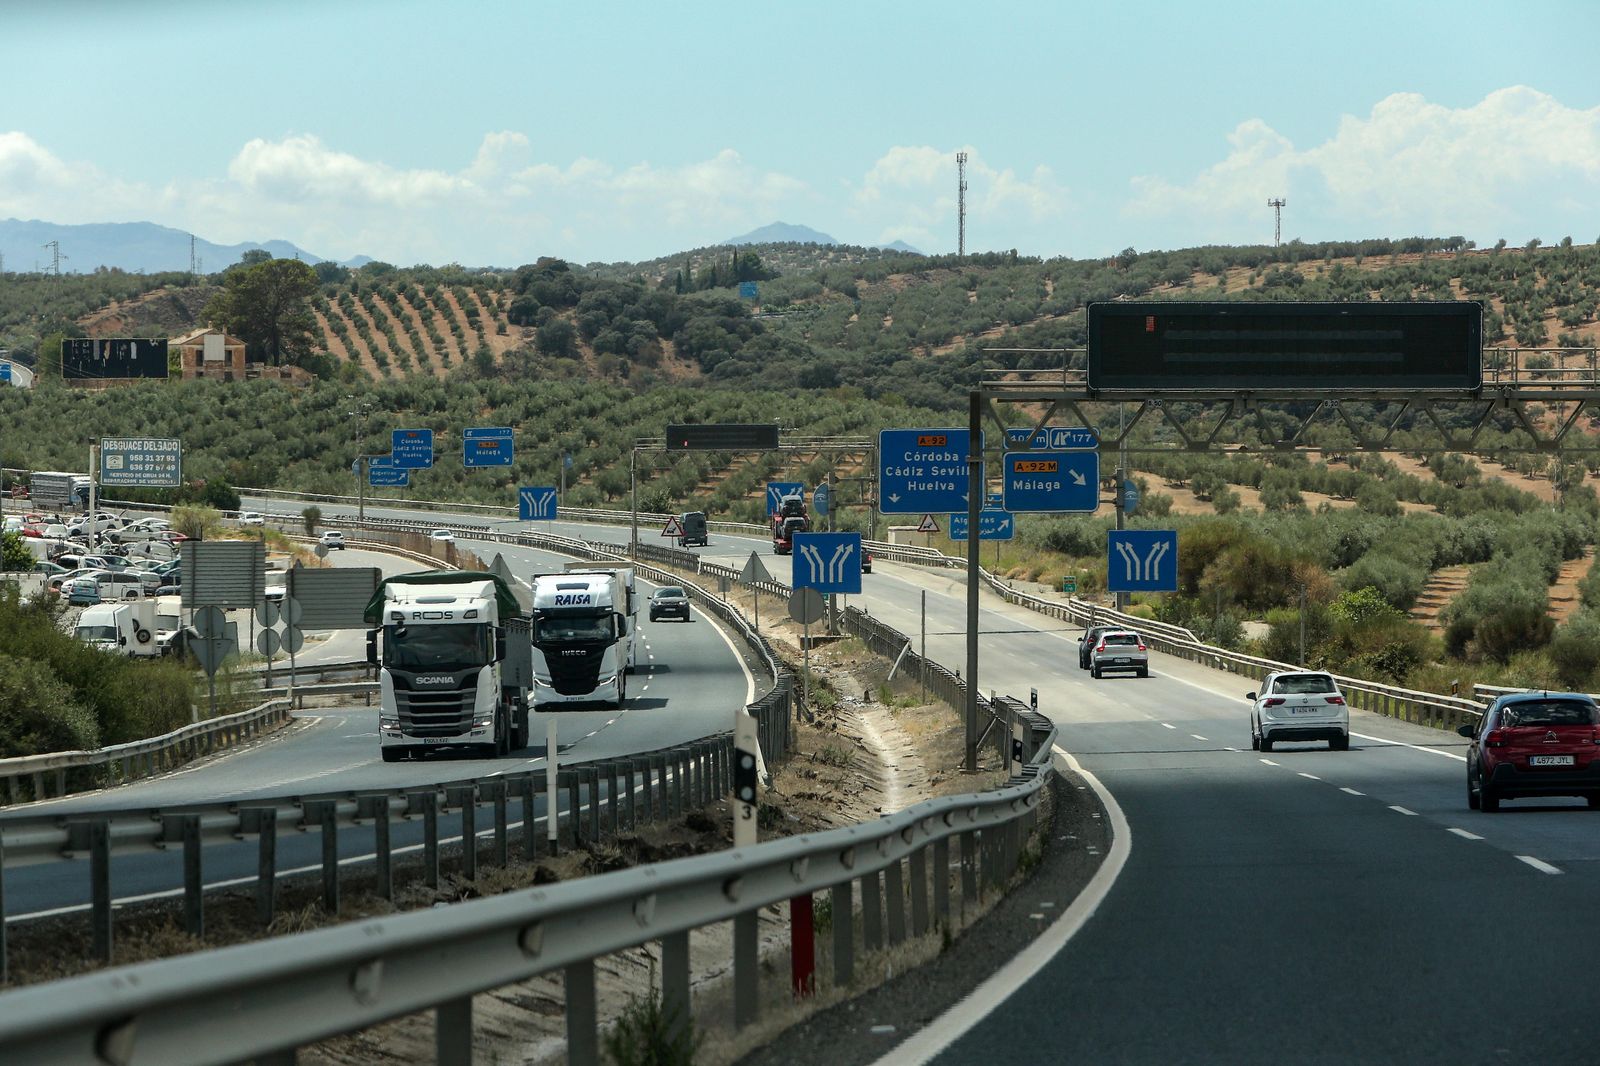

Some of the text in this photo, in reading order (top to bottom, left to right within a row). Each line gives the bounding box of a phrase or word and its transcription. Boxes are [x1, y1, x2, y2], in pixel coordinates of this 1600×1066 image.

[919, 437, 946, 445] A-92
[1072, 434, 1092, 442] 177
[103, 440, 178, 451] DESGUACE DELGADO
[129, 454, 144, 462] 958
[144, 454, 155, 462] 31
[155, 454, 165, 462] 37
[904, 451, 959, 462] Córdoba
[885, 465, 970, 476] Cádiz Sevill
[907, 480, 955, 491] Huelva
[1013, 479, 1061, 492] Málaga
[555, 594, 591, 606] RAISA
[412, 611, 454, 620] ROS
[415, 676, 455, 685] SCANIA
[1536, 756, 1570, 764] 4872 JYL
[742, 805, 752, 820] 3
